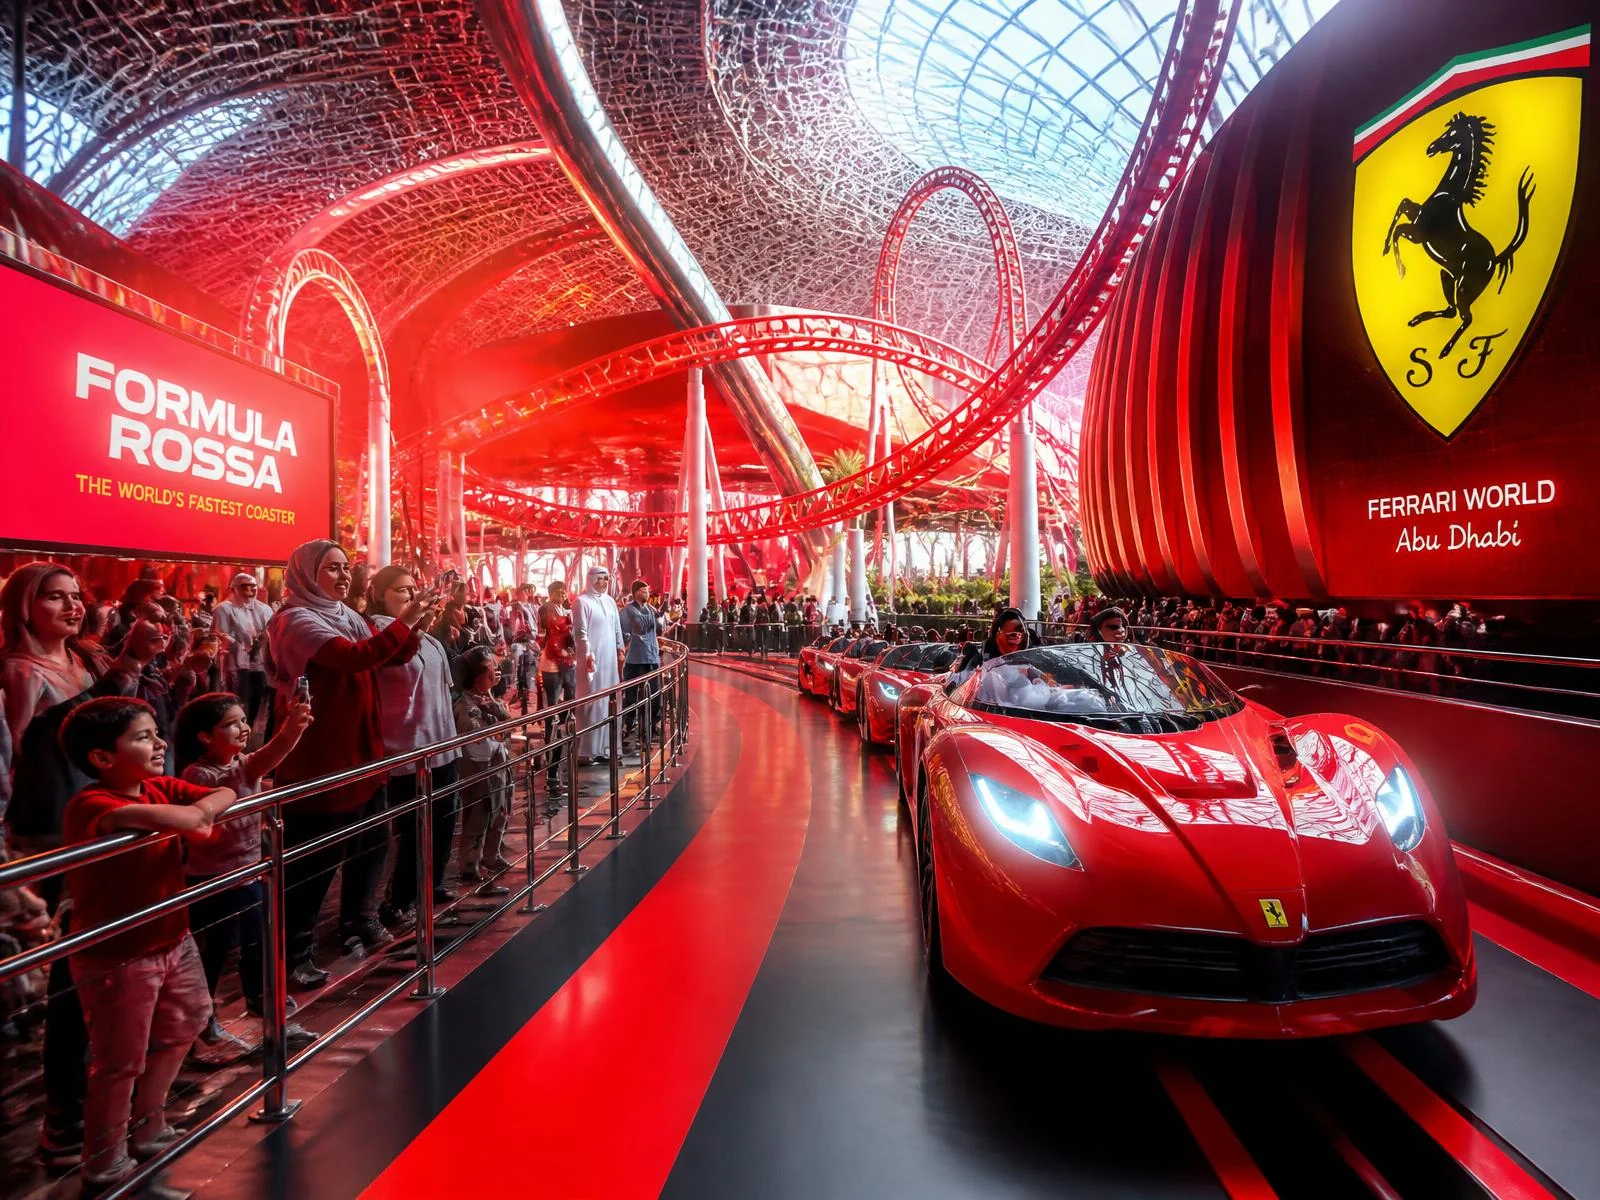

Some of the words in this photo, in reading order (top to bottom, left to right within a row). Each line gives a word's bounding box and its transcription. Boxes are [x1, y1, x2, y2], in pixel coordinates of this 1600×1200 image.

[1406, 347, 1433, 388] S
[1457, 328, 1509, 379] F
[76, 352, 297, 457] FORMULA
[108, 413, 282, 494] ROSSA
[75, 474, 112, 496] THE
[118, 481, 184, 508] WORLD'S
[189, 495, 243, 518] FASTEST
[245, 504, 295, 525] COASTER
[1368, 490, 1457, 519] FERRARI
[1463, 479, 1556, 511] WORLD
[1395, 526, 1441, 552] Abu
[1447, 520, 1521, 550] Dhabi
